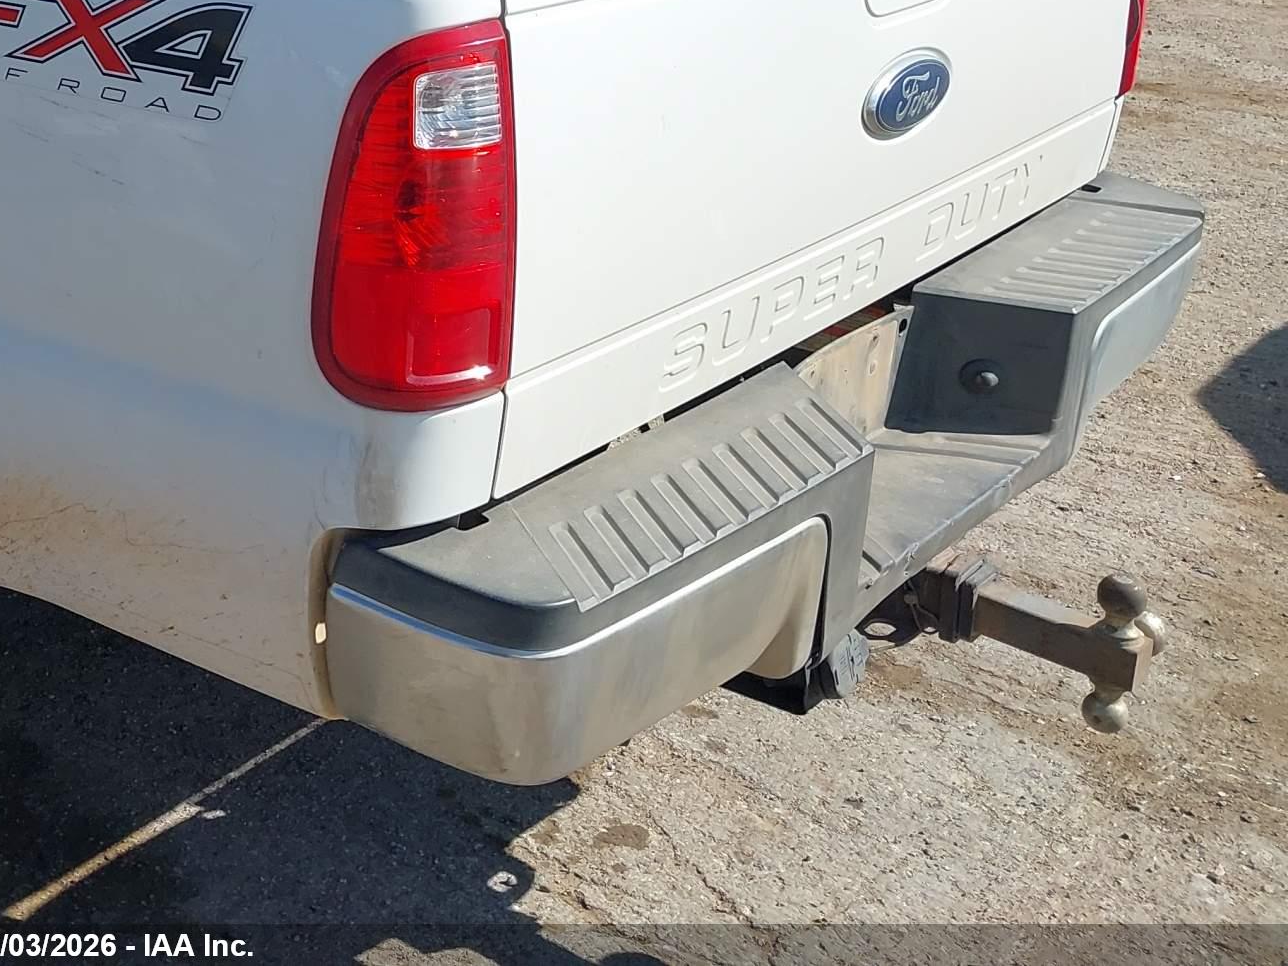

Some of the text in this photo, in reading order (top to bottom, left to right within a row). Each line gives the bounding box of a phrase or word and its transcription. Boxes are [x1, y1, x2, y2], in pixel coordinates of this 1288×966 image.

[57, 78, 222, 121] ROAD
[895, 71, 941, 122] Ford
[658, 154, 1044, 393] SUPER DUTY
